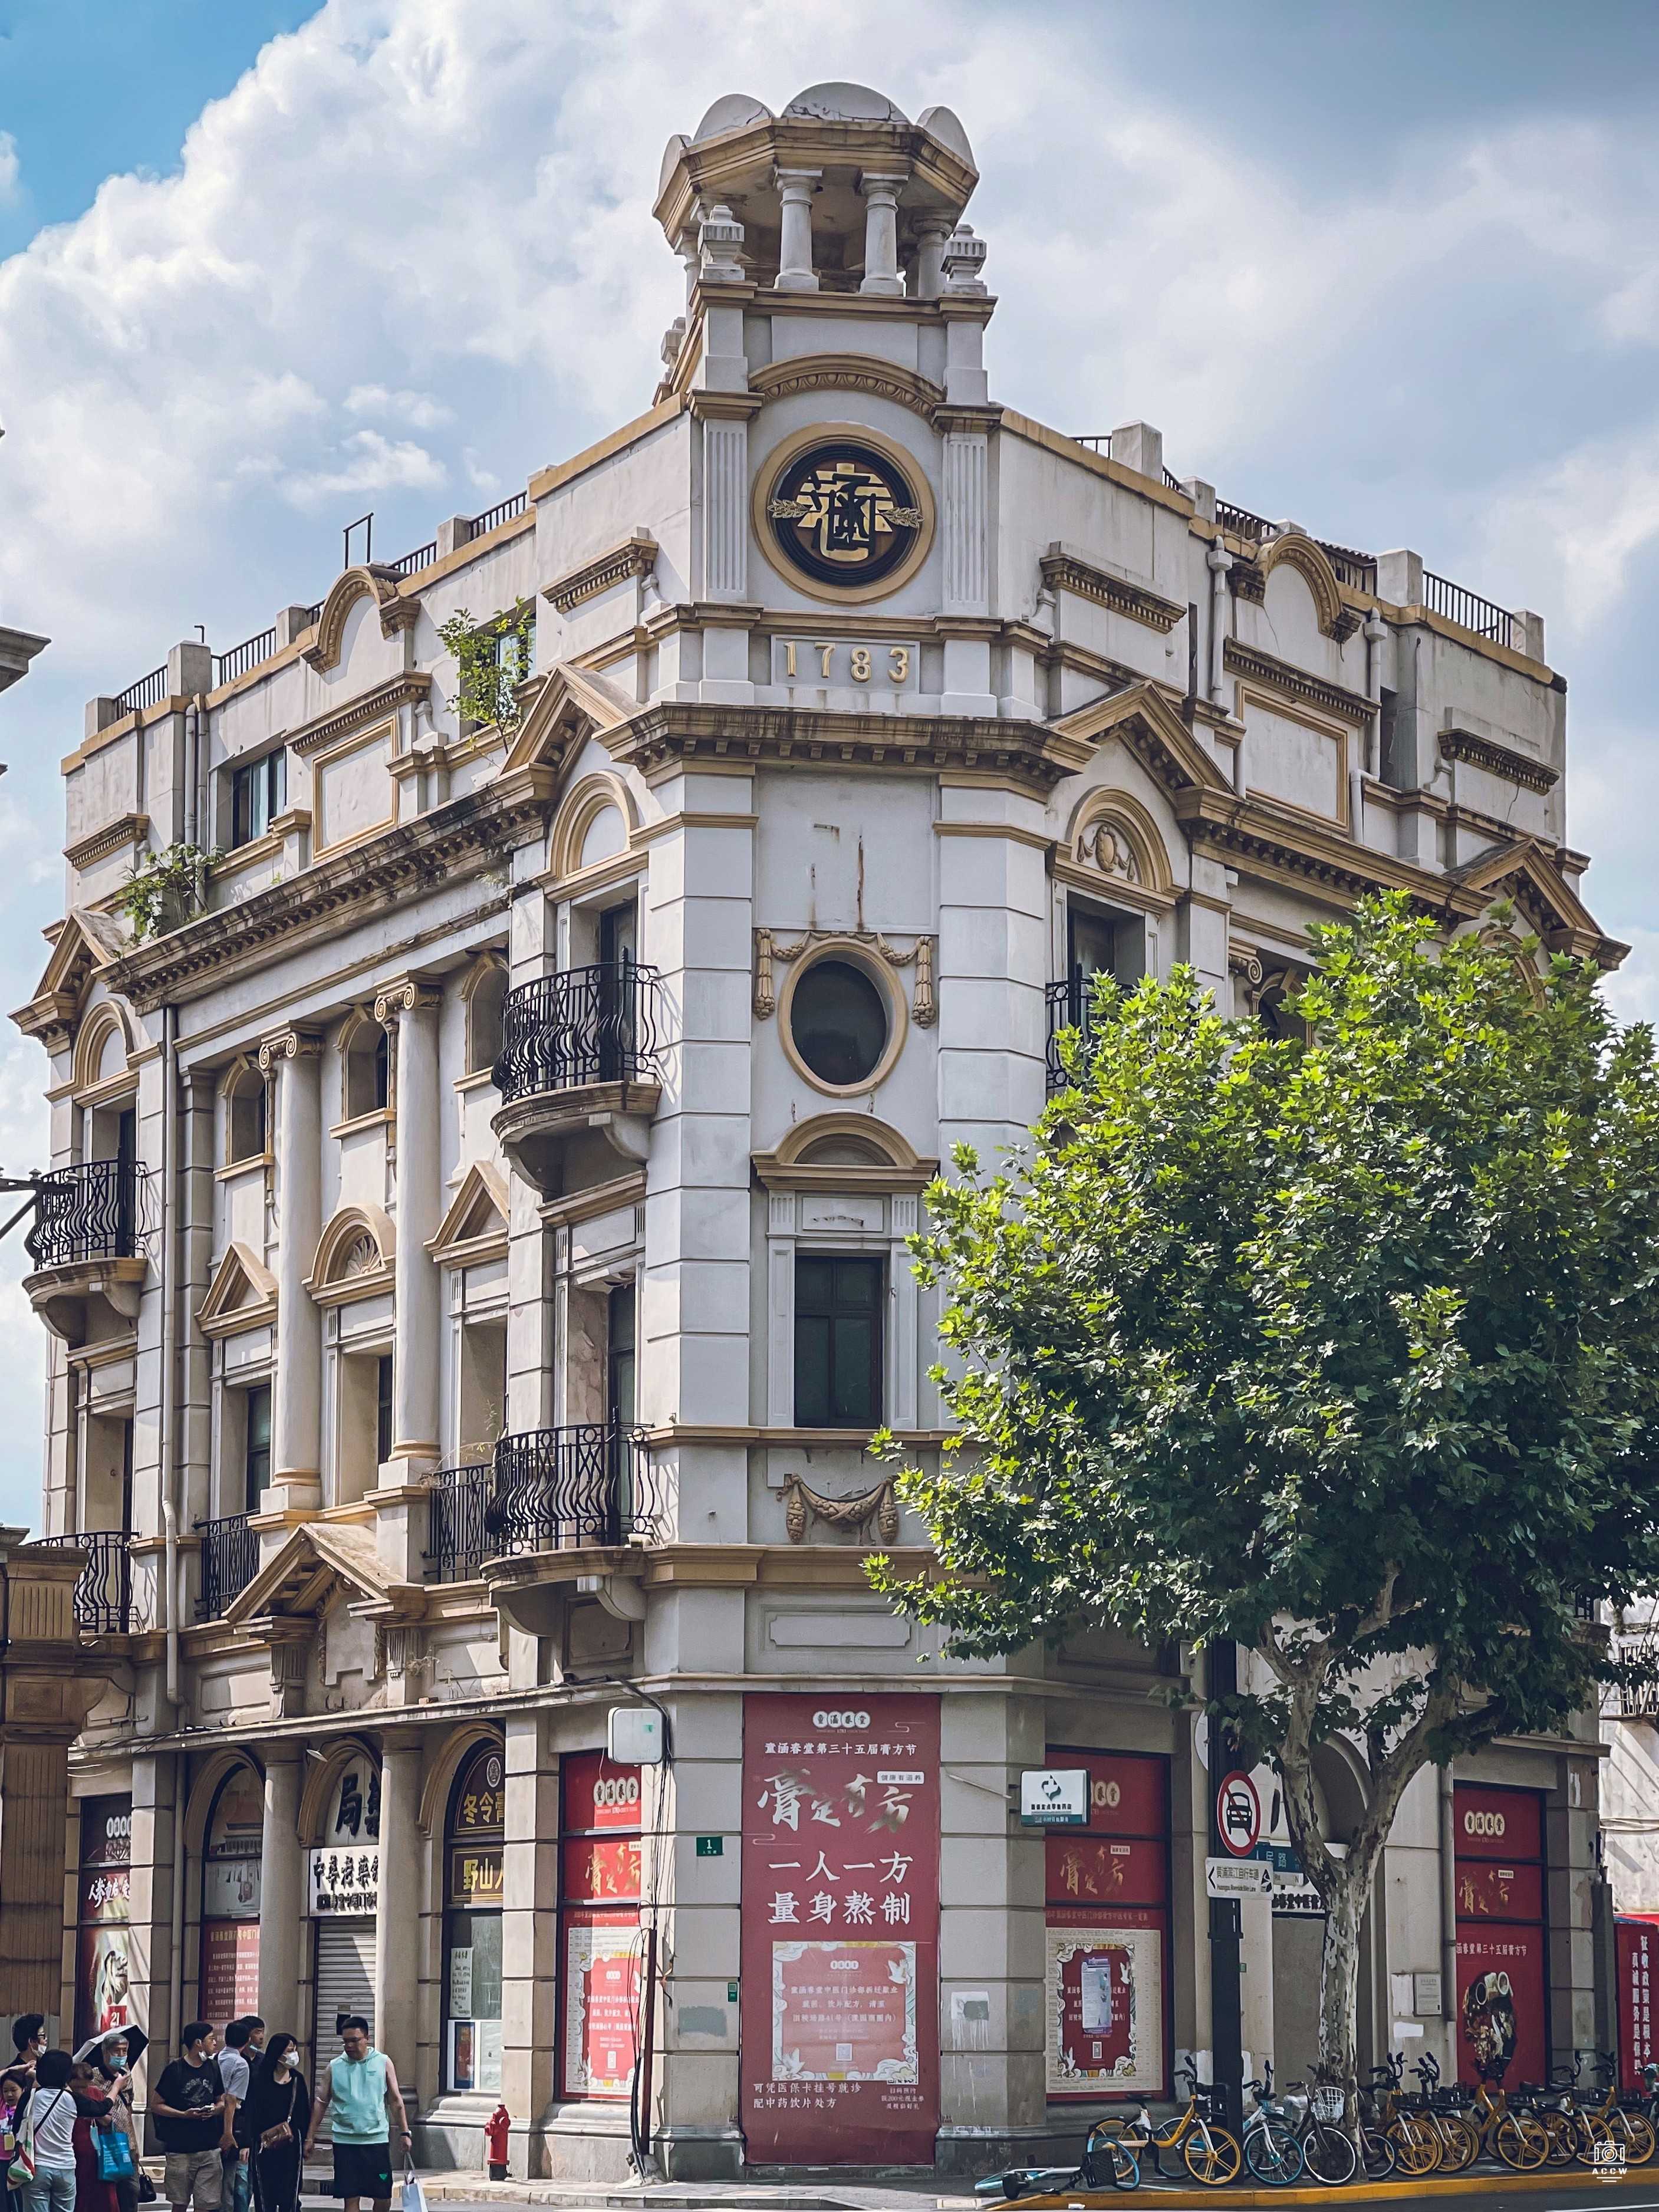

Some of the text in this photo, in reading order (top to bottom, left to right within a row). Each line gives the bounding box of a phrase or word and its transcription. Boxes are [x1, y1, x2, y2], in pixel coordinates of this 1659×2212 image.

[784, 641, 910, 683] 1783
[765, 1742, 917, 1756] 童涵春堂第三十五届膏方节
[706, 1839, 713, 1849] 1
[768, 1851, 913, 1883] 一人一方
[768, 1890, 911, 1925] 量身熬制
[753, 2082, 862, 2094] 可凭医保卡挂号就诊
[753, 2098, 837, 2109] 配中药饮片处方
